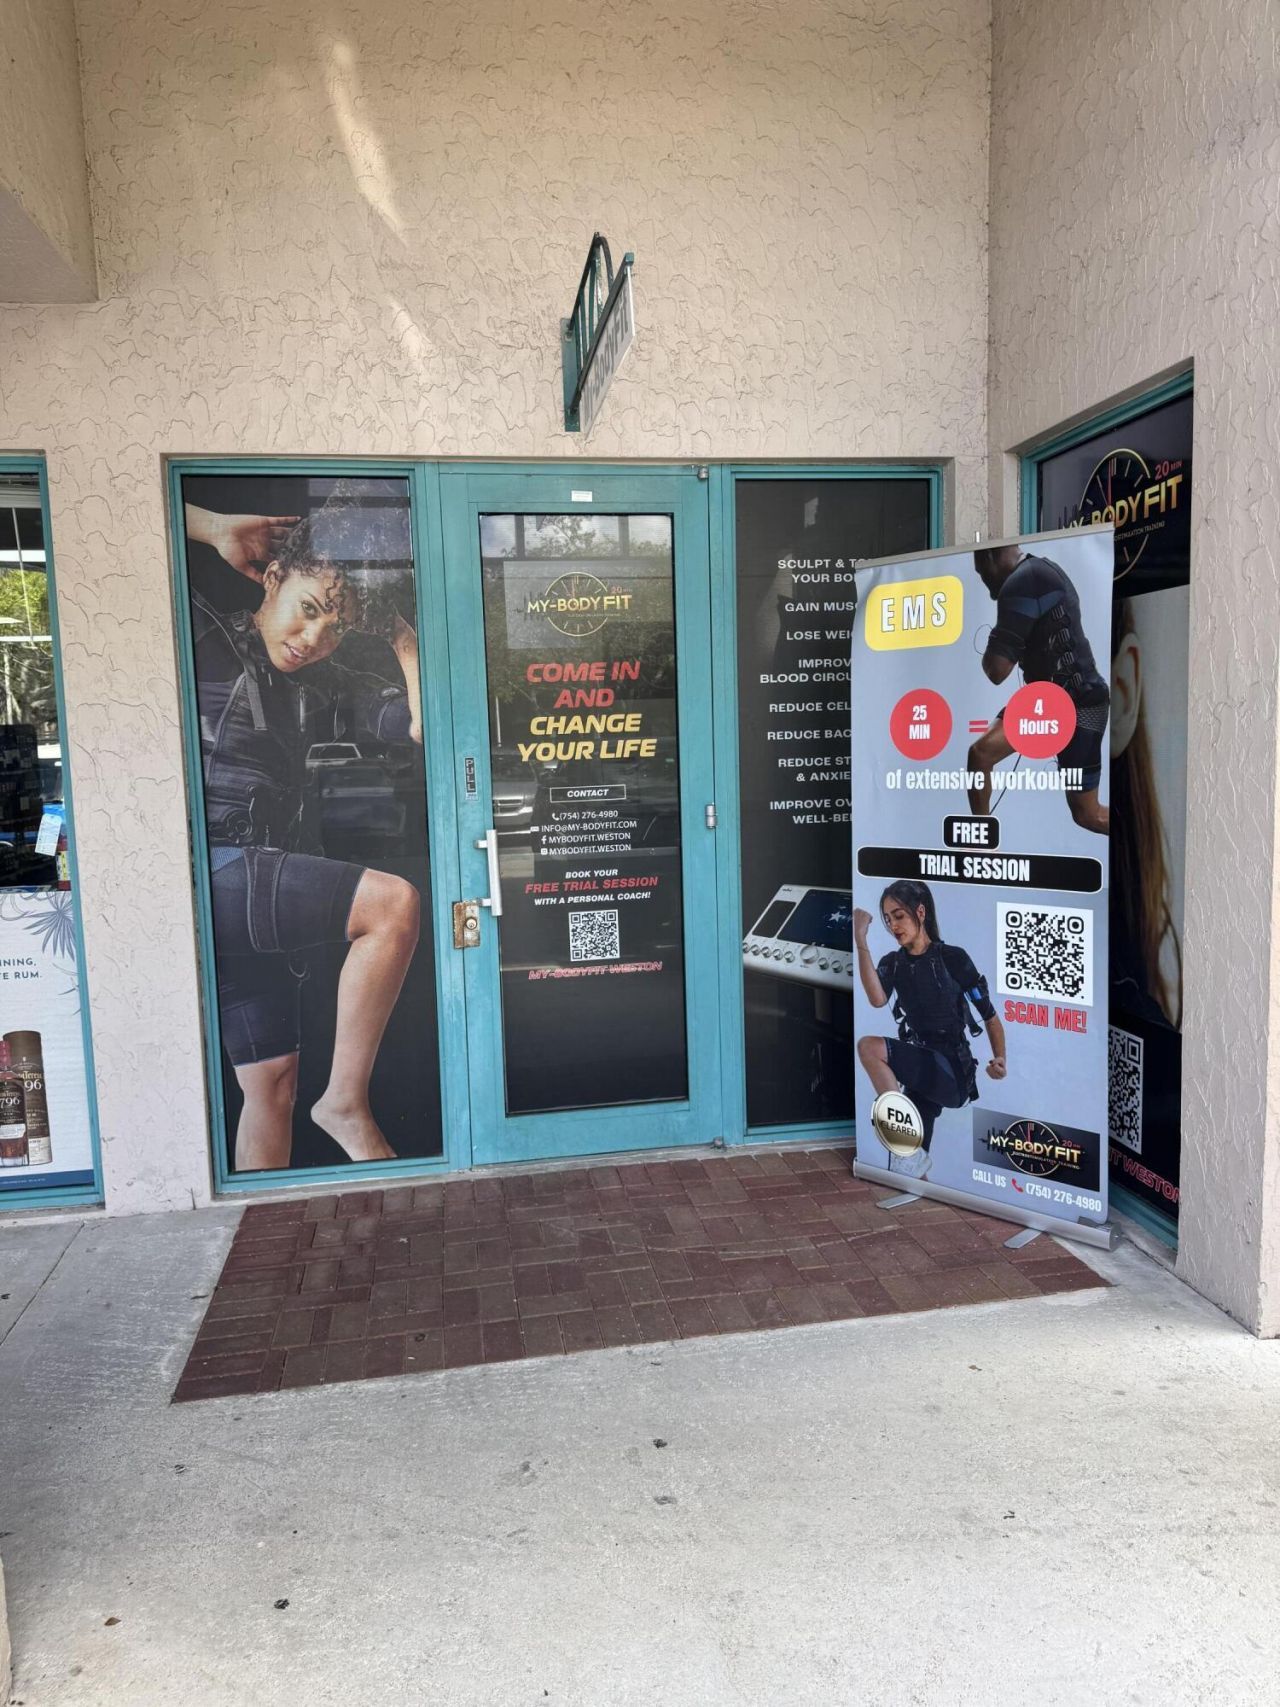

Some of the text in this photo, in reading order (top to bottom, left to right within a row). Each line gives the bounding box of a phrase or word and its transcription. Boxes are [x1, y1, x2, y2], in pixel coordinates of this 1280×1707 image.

[1154, 461, 1170, 480] 20
[777, 559, 831, 569] SCULPT
[835, 558, 845, 568] &
[791, 573, 830, 583] YOUR
[784, 602, 820, 612] GAIN
[786, 630, 854, 640] LOSE WEI
[798, 658, 852, 668] IMPROV
[527, 660, 641, 683] COME IN
[760, 673, 809, 683] BLOOD
[554, 688, 614, 709] AND
[769, 702, 823, 712] REDUCE
[912, 705, 927, 721] 25
[1034, 699, 1044, 715] 4
[530, 713, 642, 736] CHANGE
[909, 724, 930, 740] MIN
[1019, 718, 1059, 736] Hours
[767, 729, 852, 740] REDUCE BAC
[517, 738, 657, 763] YOUR LIFE
[778, 756, 852, 768] REDUCE ST
[465, 759, 475, 791] PULL
[796, 771, 851, 782] & ANXIE
[886, 768, 1083, 791] of extensive workout!!!
[567, 789, 609, 798] CONTACT
[769, 798, 831, 810] IMPROVE
[560, 810, 618, 821] (754) 276-4980
[541, 820, 637, 833] INFO@MY-BODYFIT.COM
[952, 822, 989, 844] FREE
[548, 832, 631, 844] MYBODYFIT.WESTON
[549, 844, 631, 856] MYBODYFIT.WESTON
[565, 869, 618, 879] BOOK YOUR
[919, 853, 1030, 881] TRIAL SESSION
[525, 876, 658, 893] FREE TRIAL SESSION
[534, 891, 651, 906] WITH A PERSONAL COACH!
[1004, 999, 1087, 1034] SCAN ME!
[887, 1106, 914, 1127] FDA
[880, 1120, 918, 1137] CLEARED
[972, 1168, 1102, 1213] CALL US (754) 276-4980
